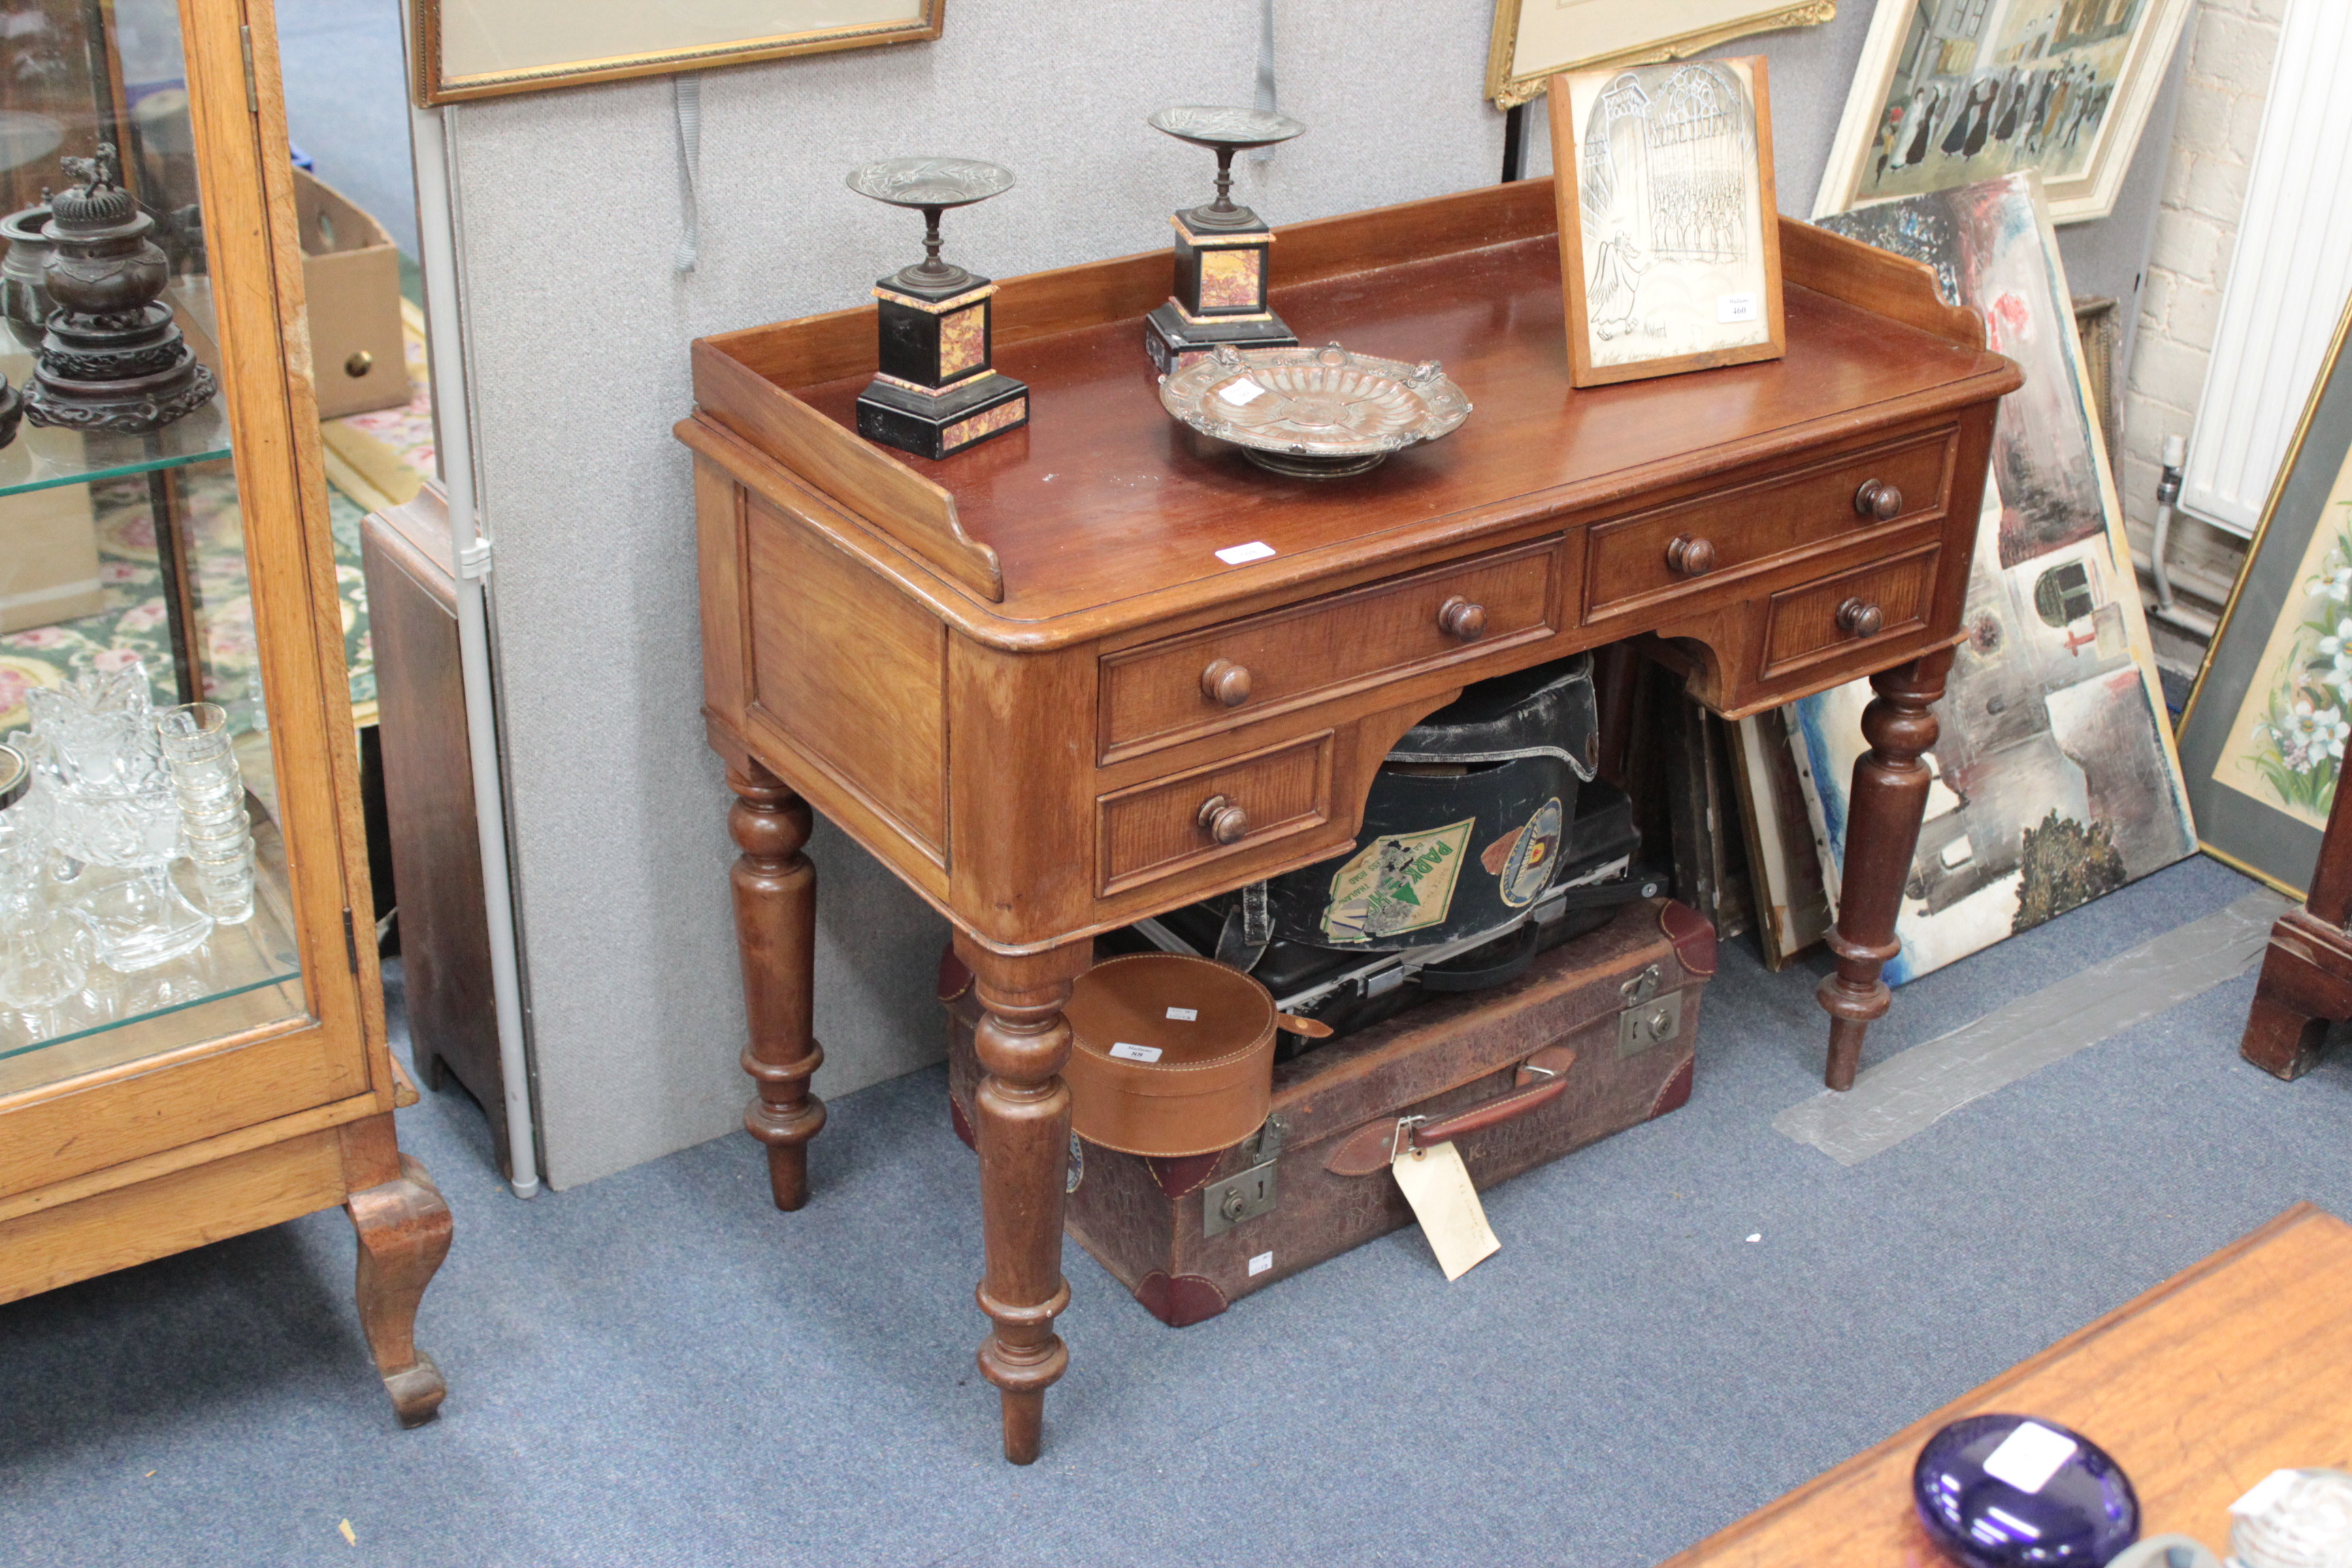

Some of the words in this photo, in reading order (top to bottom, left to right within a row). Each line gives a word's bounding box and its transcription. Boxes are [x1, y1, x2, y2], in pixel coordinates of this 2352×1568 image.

[1732, 306, 1746, 314] 460
[1399, 840, 1454, 885] PARK
[1350, 871, 1367, 885] ROAD
